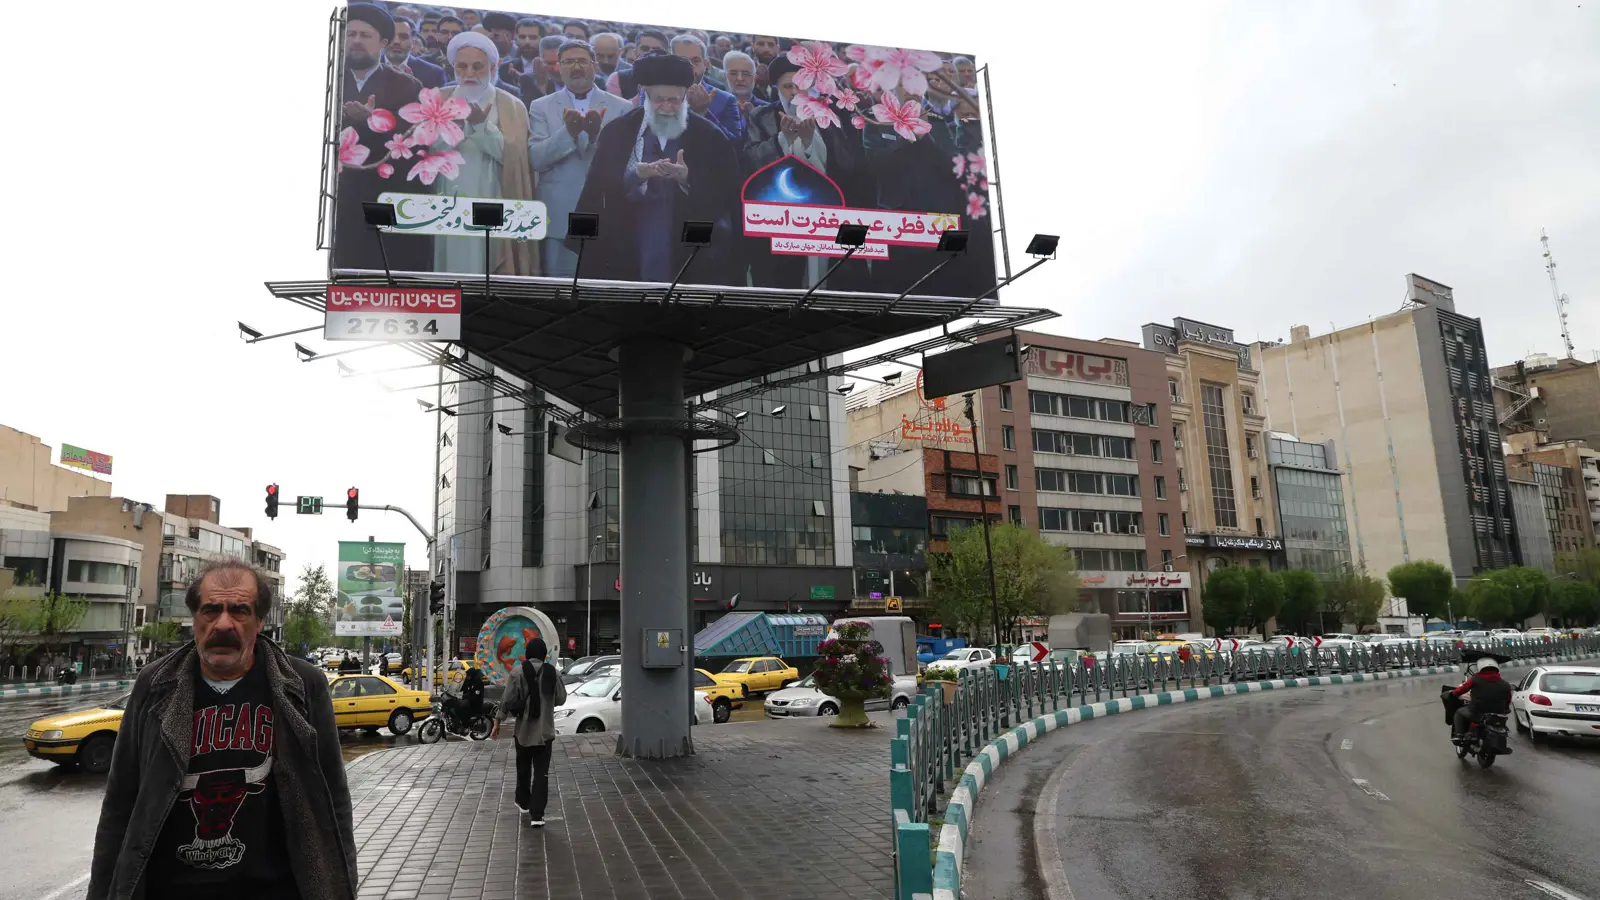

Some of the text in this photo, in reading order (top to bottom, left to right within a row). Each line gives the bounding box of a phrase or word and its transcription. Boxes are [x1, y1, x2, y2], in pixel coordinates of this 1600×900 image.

[746, 208, 790, 227] است
[514, 215, 542, 243] عید
[774, 240, 783, 248] باد
[783, 241, 800, 251] مبارک
[800, 243, 816, 252] جهان
[331, 290, 457, 308] کانون ایران نوین
[347, 317, 439, 336] 27634
[693, 571, 712, 592] بان
[191, 702, 277, 758] ICAG
[185, 846, 237, 863] Windy City
